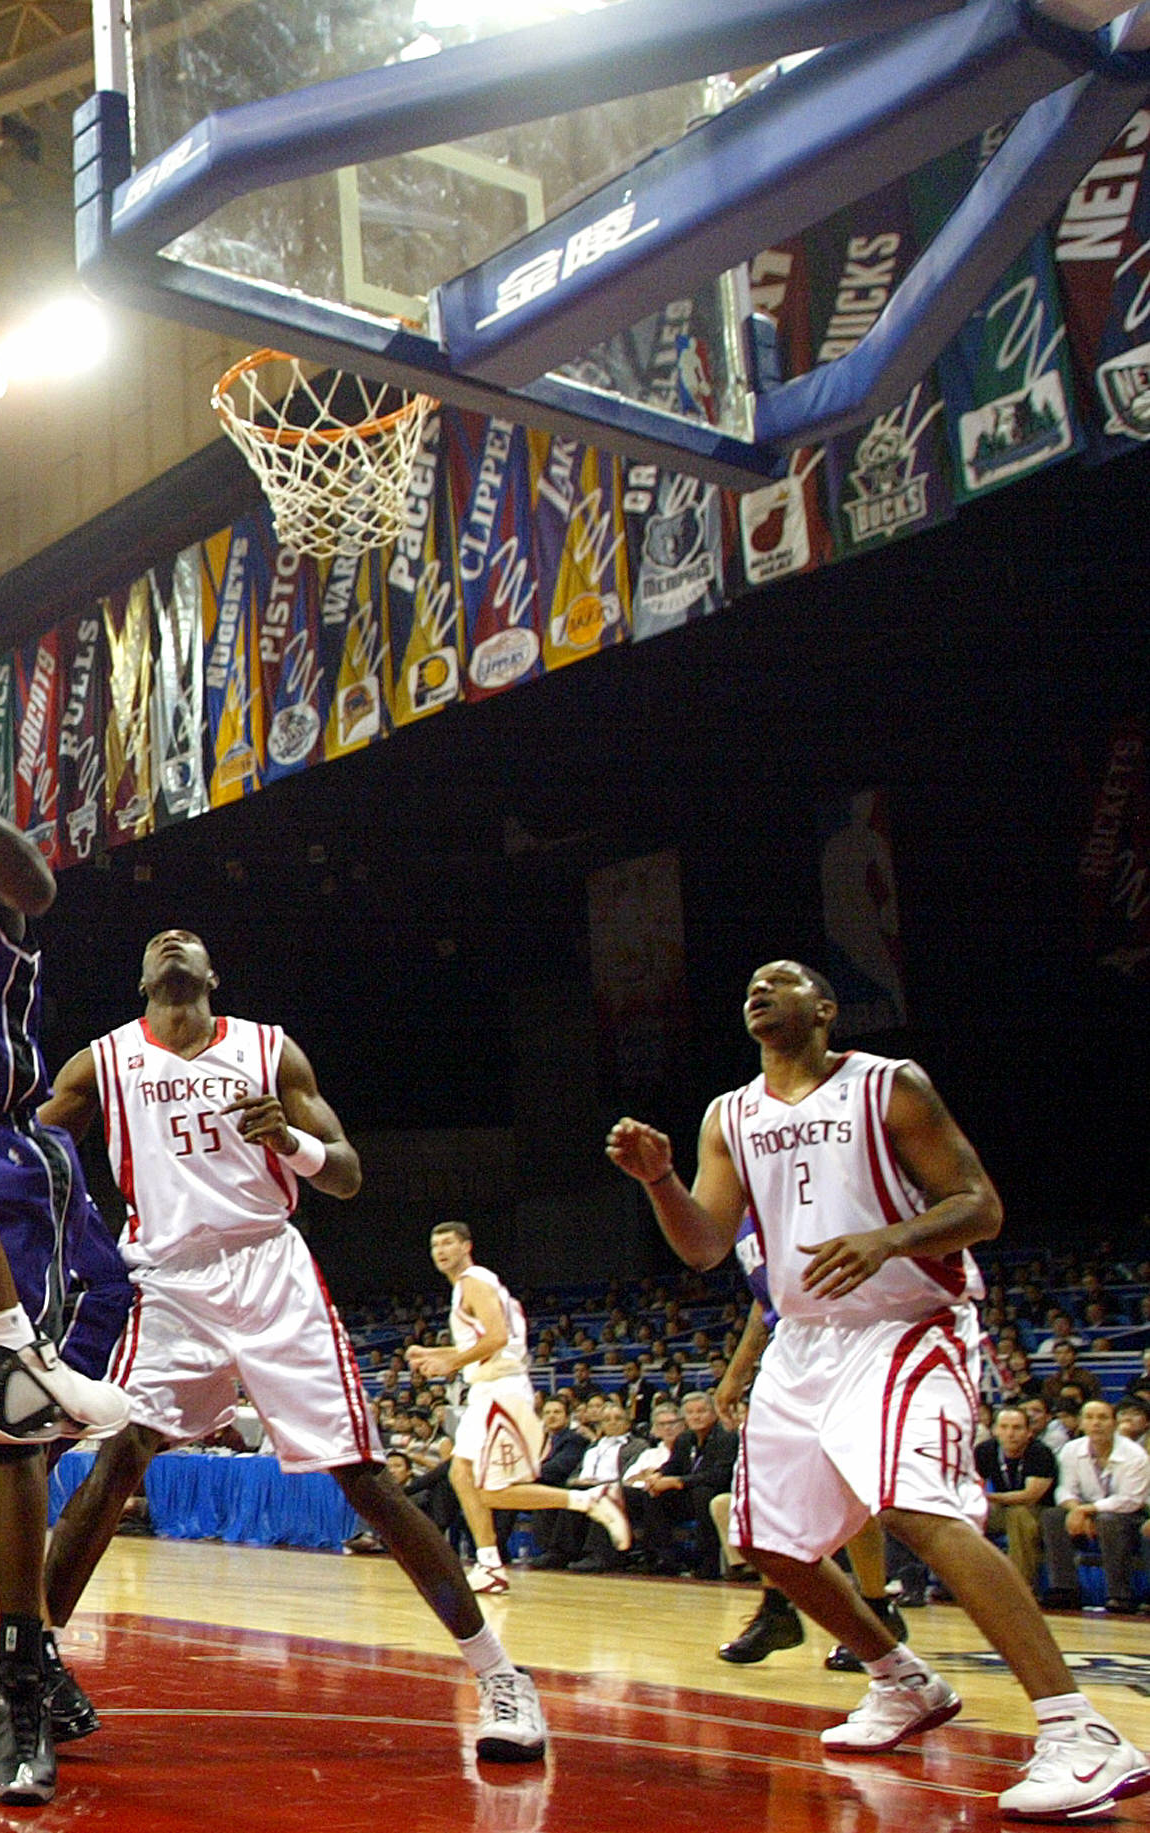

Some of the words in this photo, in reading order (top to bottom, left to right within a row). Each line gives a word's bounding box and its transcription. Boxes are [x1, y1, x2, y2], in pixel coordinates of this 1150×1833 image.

[205, 536, 249, 690] NUGGETS
[137, 1077, 249, 1107] ROCKETS
[170, 1111, 221, 1157] 55
[747, 1119, 852, 1160] ROCKETS
[794, 1161, 814, 1206] 2
